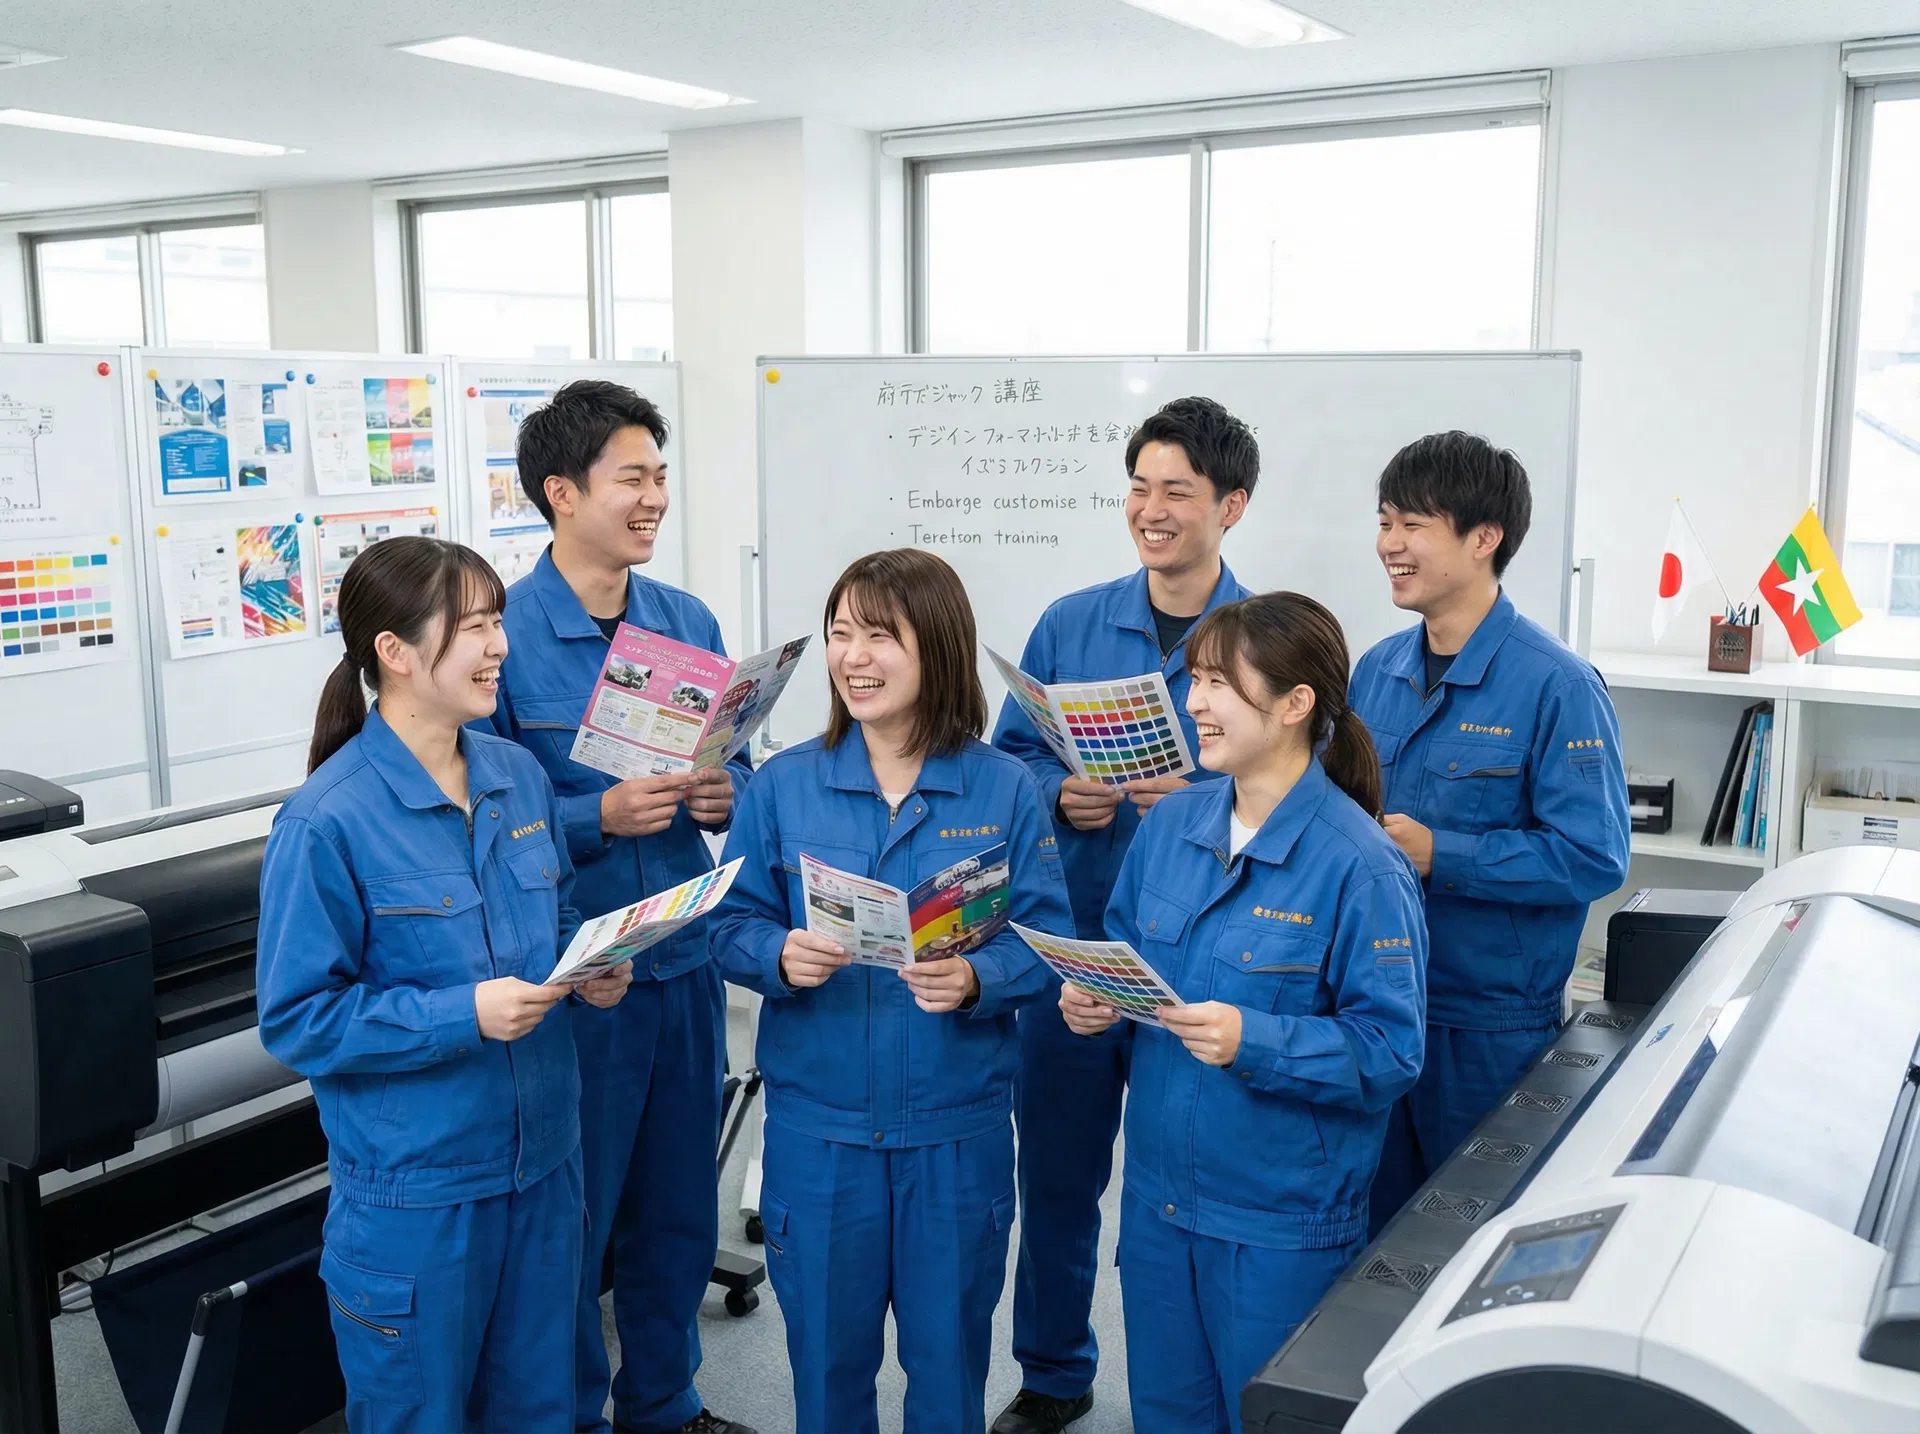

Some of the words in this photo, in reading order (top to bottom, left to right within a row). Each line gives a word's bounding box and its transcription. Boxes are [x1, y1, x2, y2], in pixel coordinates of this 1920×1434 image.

[994, 376, 1044, 404] 講座
[908, 490, 982, 515] Embarge
[993, 493, 1077, 510] customise
[994, 529, 1060, 548] training
